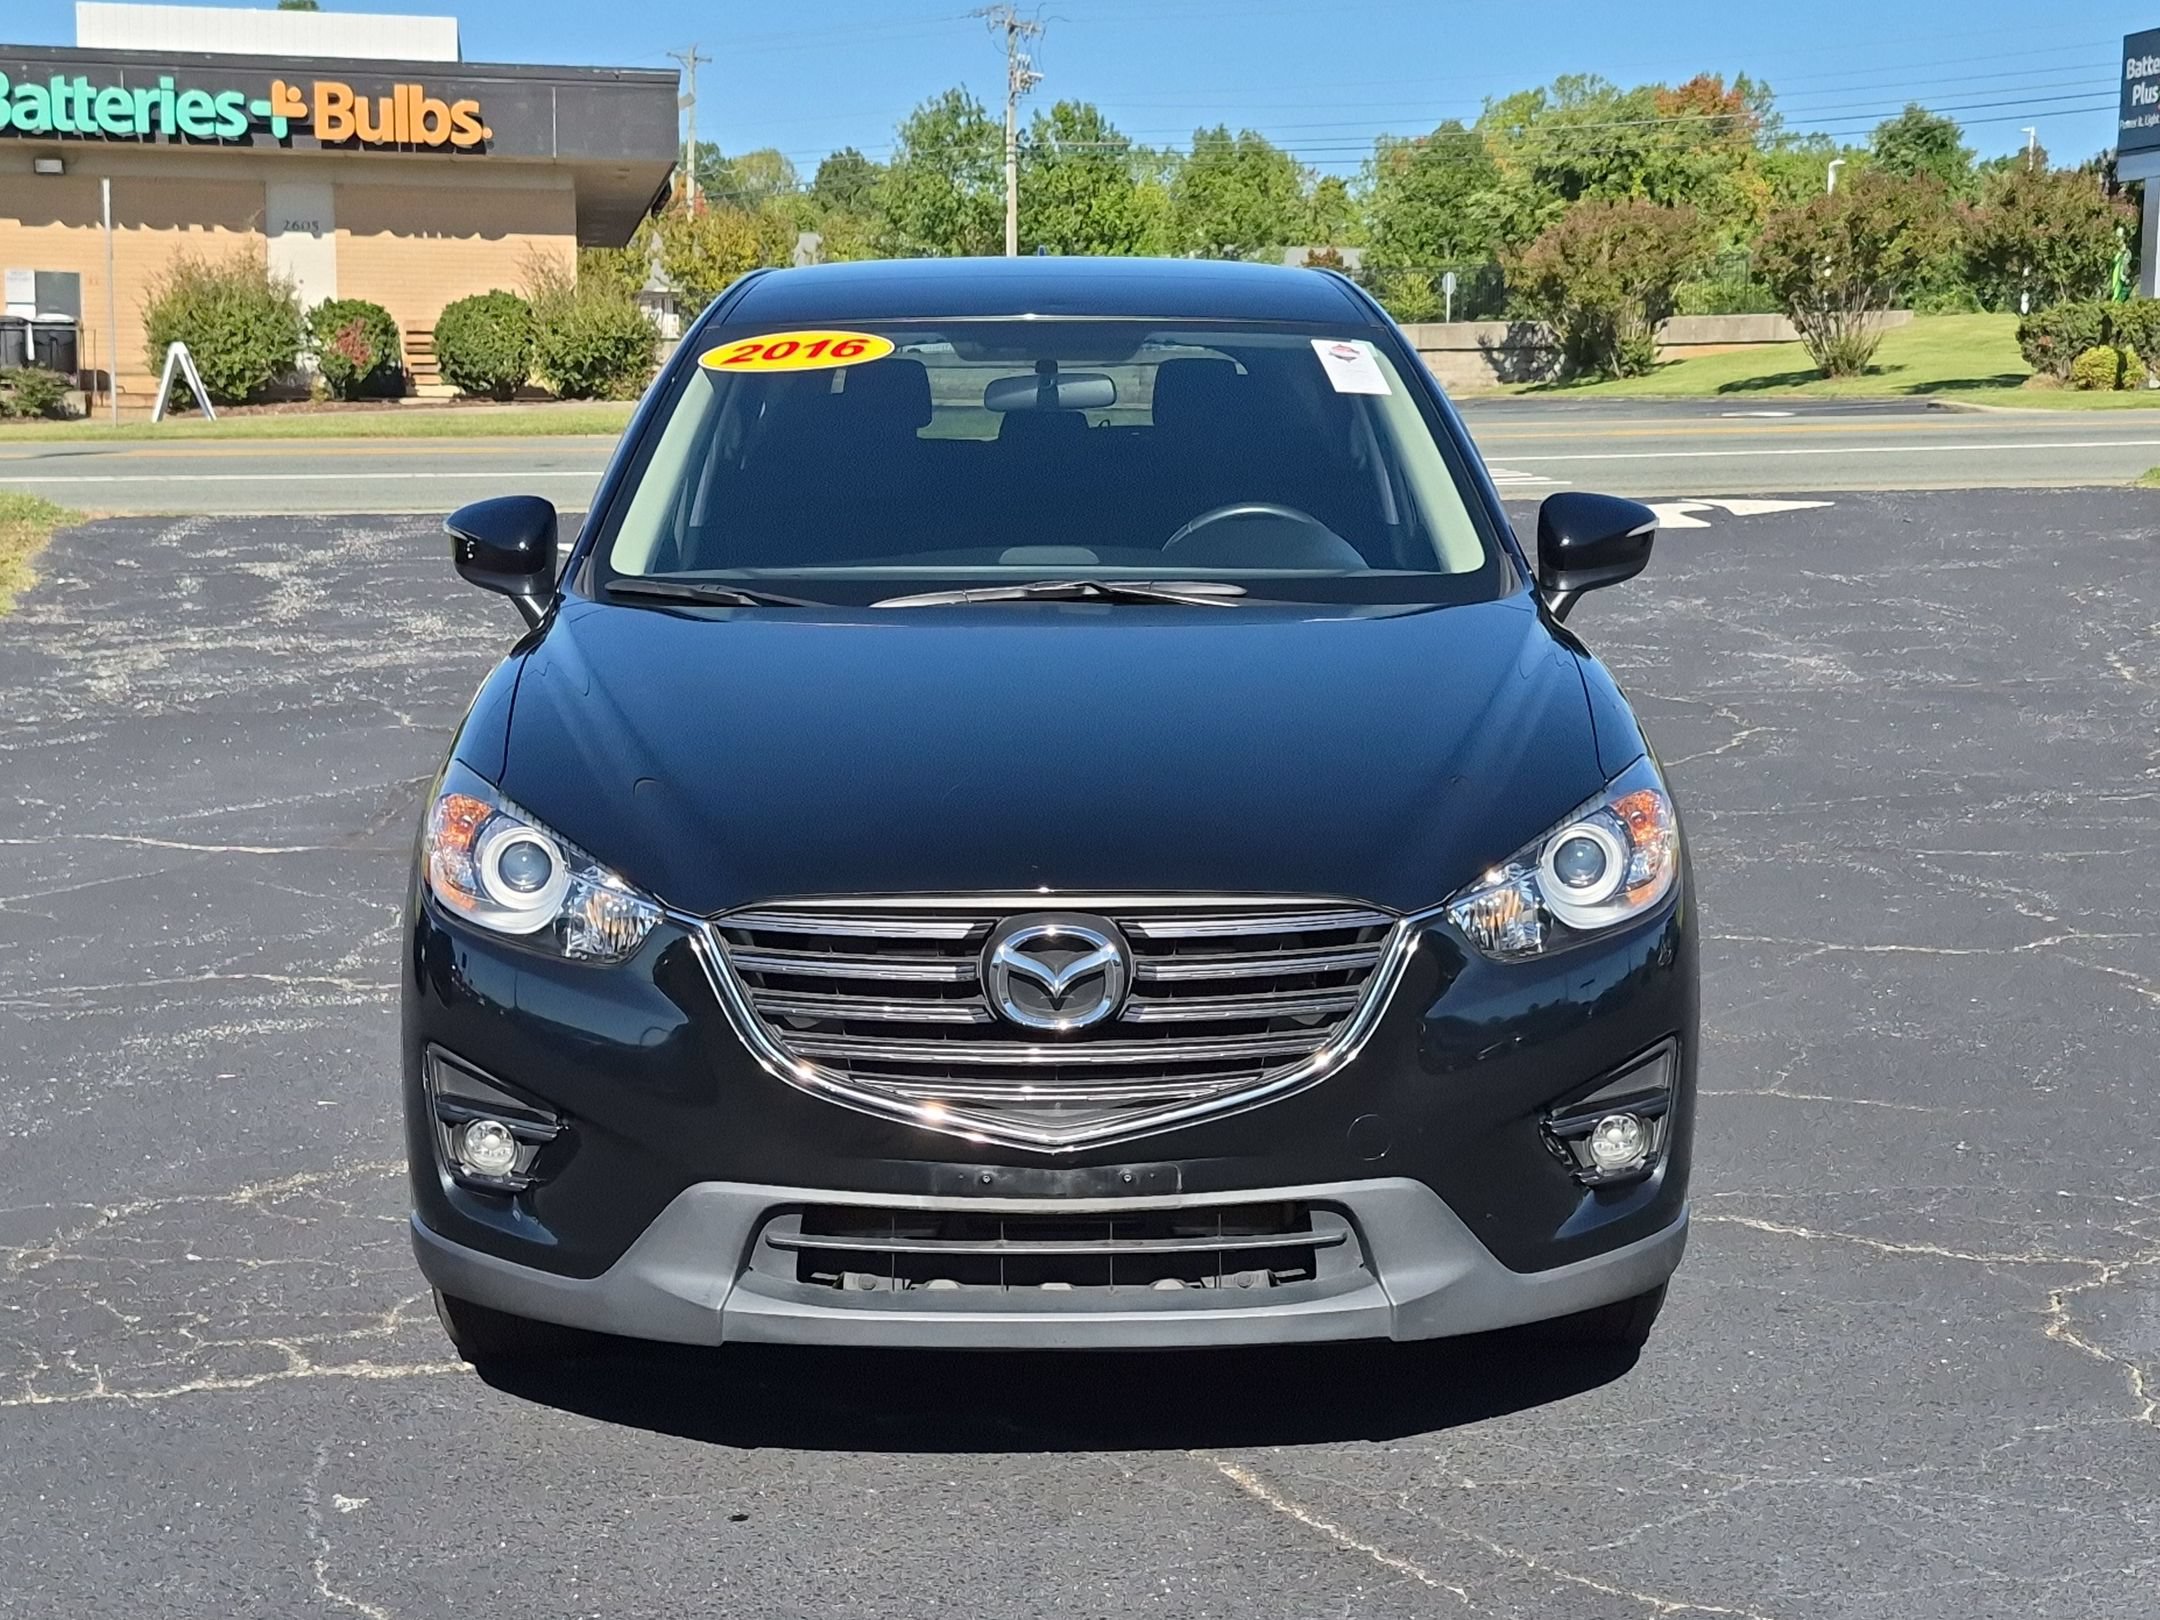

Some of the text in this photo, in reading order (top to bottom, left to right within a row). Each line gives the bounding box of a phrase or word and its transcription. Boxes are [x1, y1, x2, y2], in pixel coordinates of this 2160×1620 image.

[0, 71, 248, 137] atteries
[2132, 81, 2159, 106] Plus
[283, 220, 319, 232] 2605
[720, 339, 870, 366] 2016
